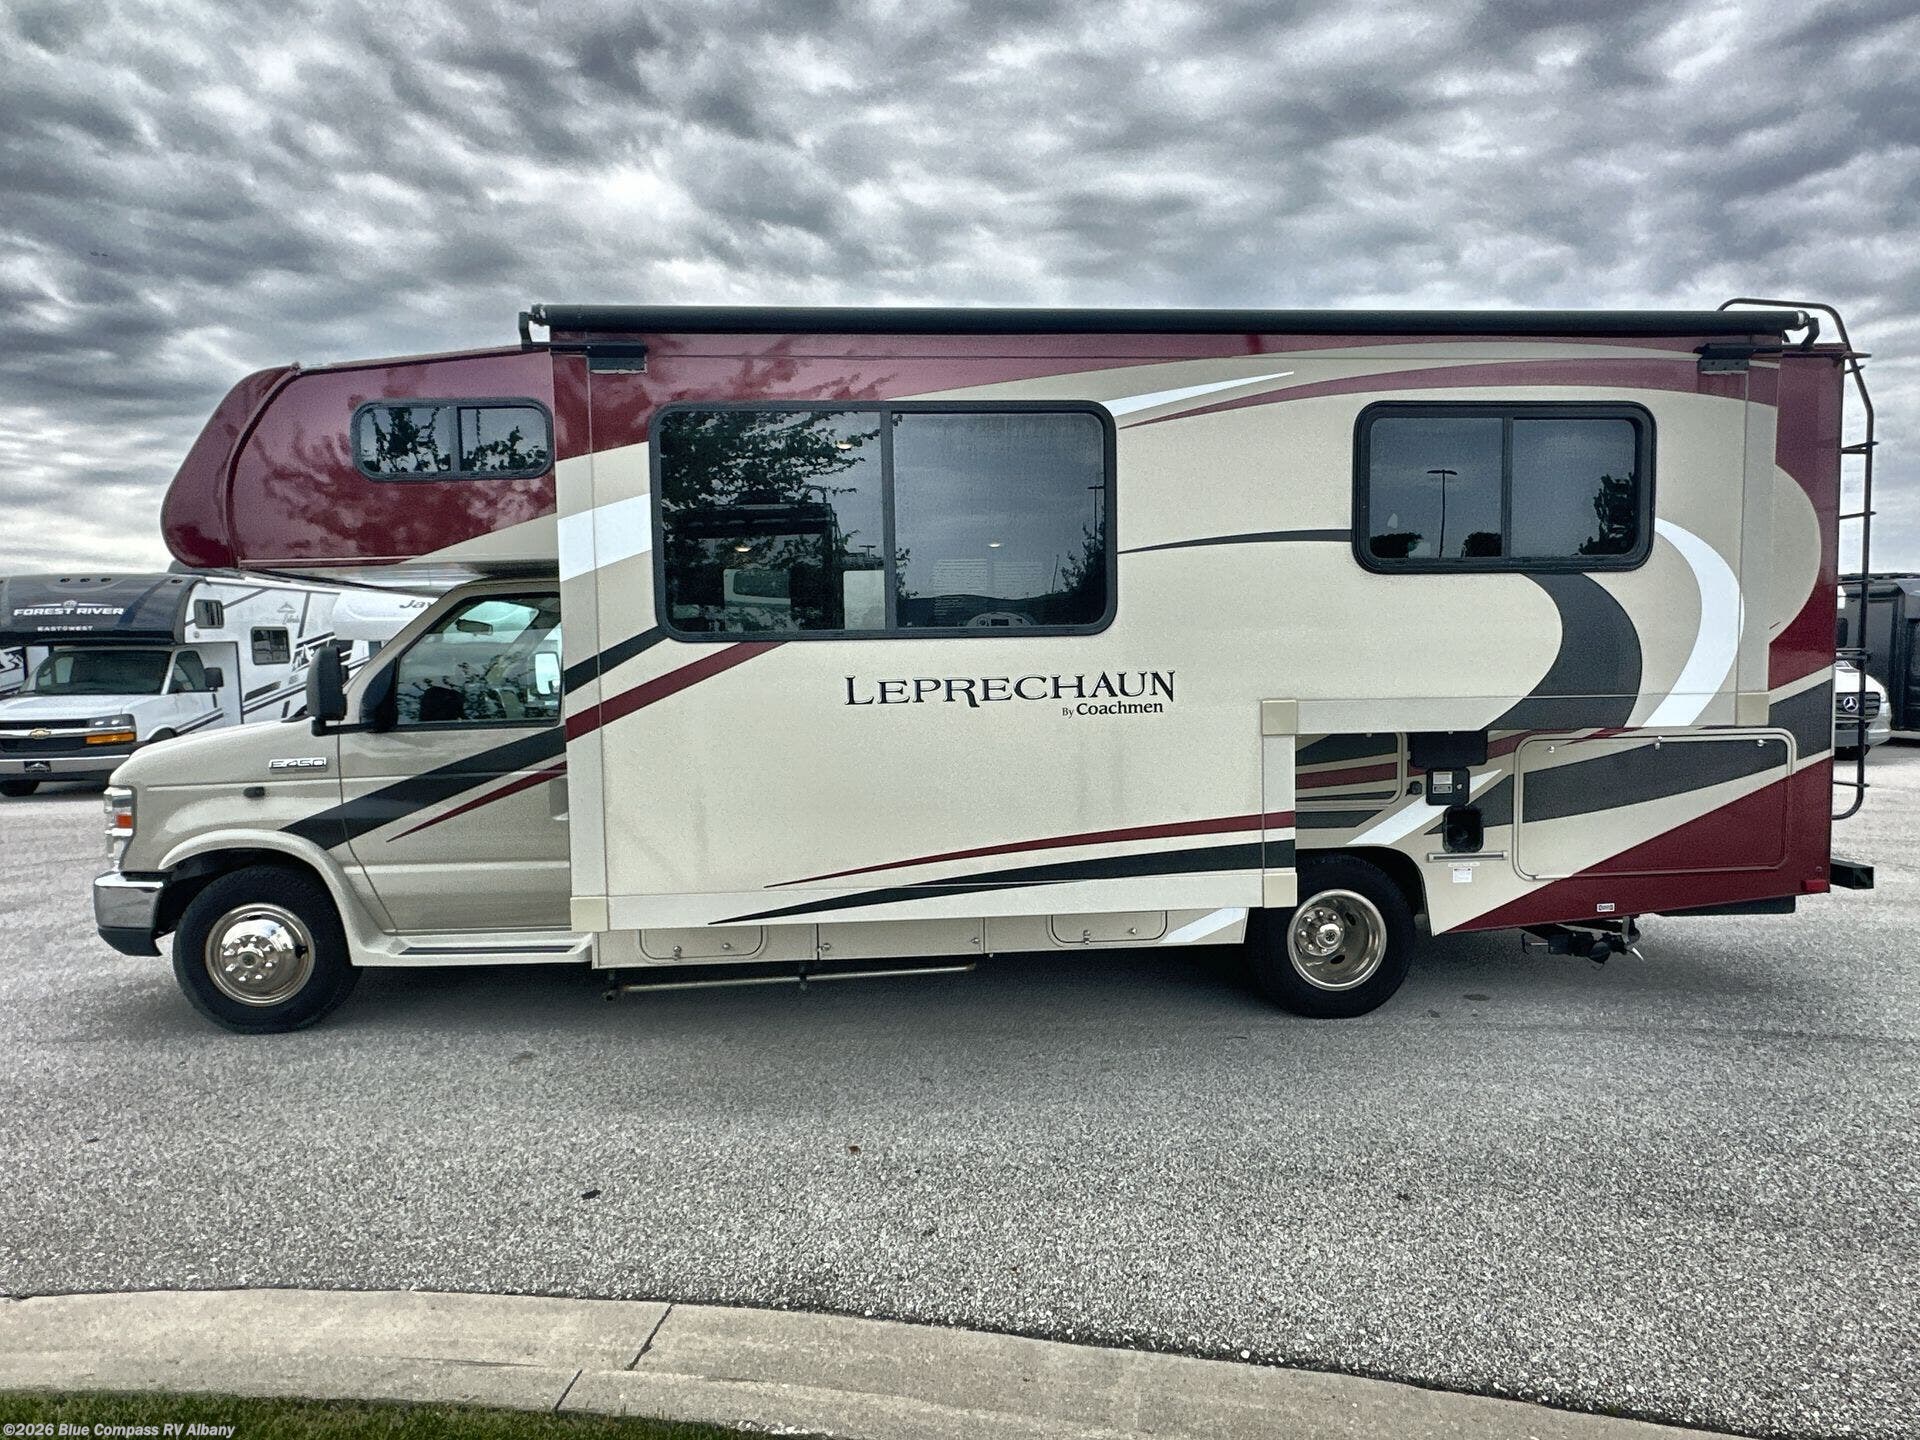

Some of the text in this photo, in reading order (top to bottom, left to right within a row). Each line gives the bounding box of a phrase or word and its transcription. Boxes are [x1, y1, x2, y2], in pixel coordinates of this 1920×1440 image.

[13, 608, 75, 616] FOREST
[844, 670, 1176, 708] LEPRECHAUN
[1062, 701, 1164, 718] By Coachmen
